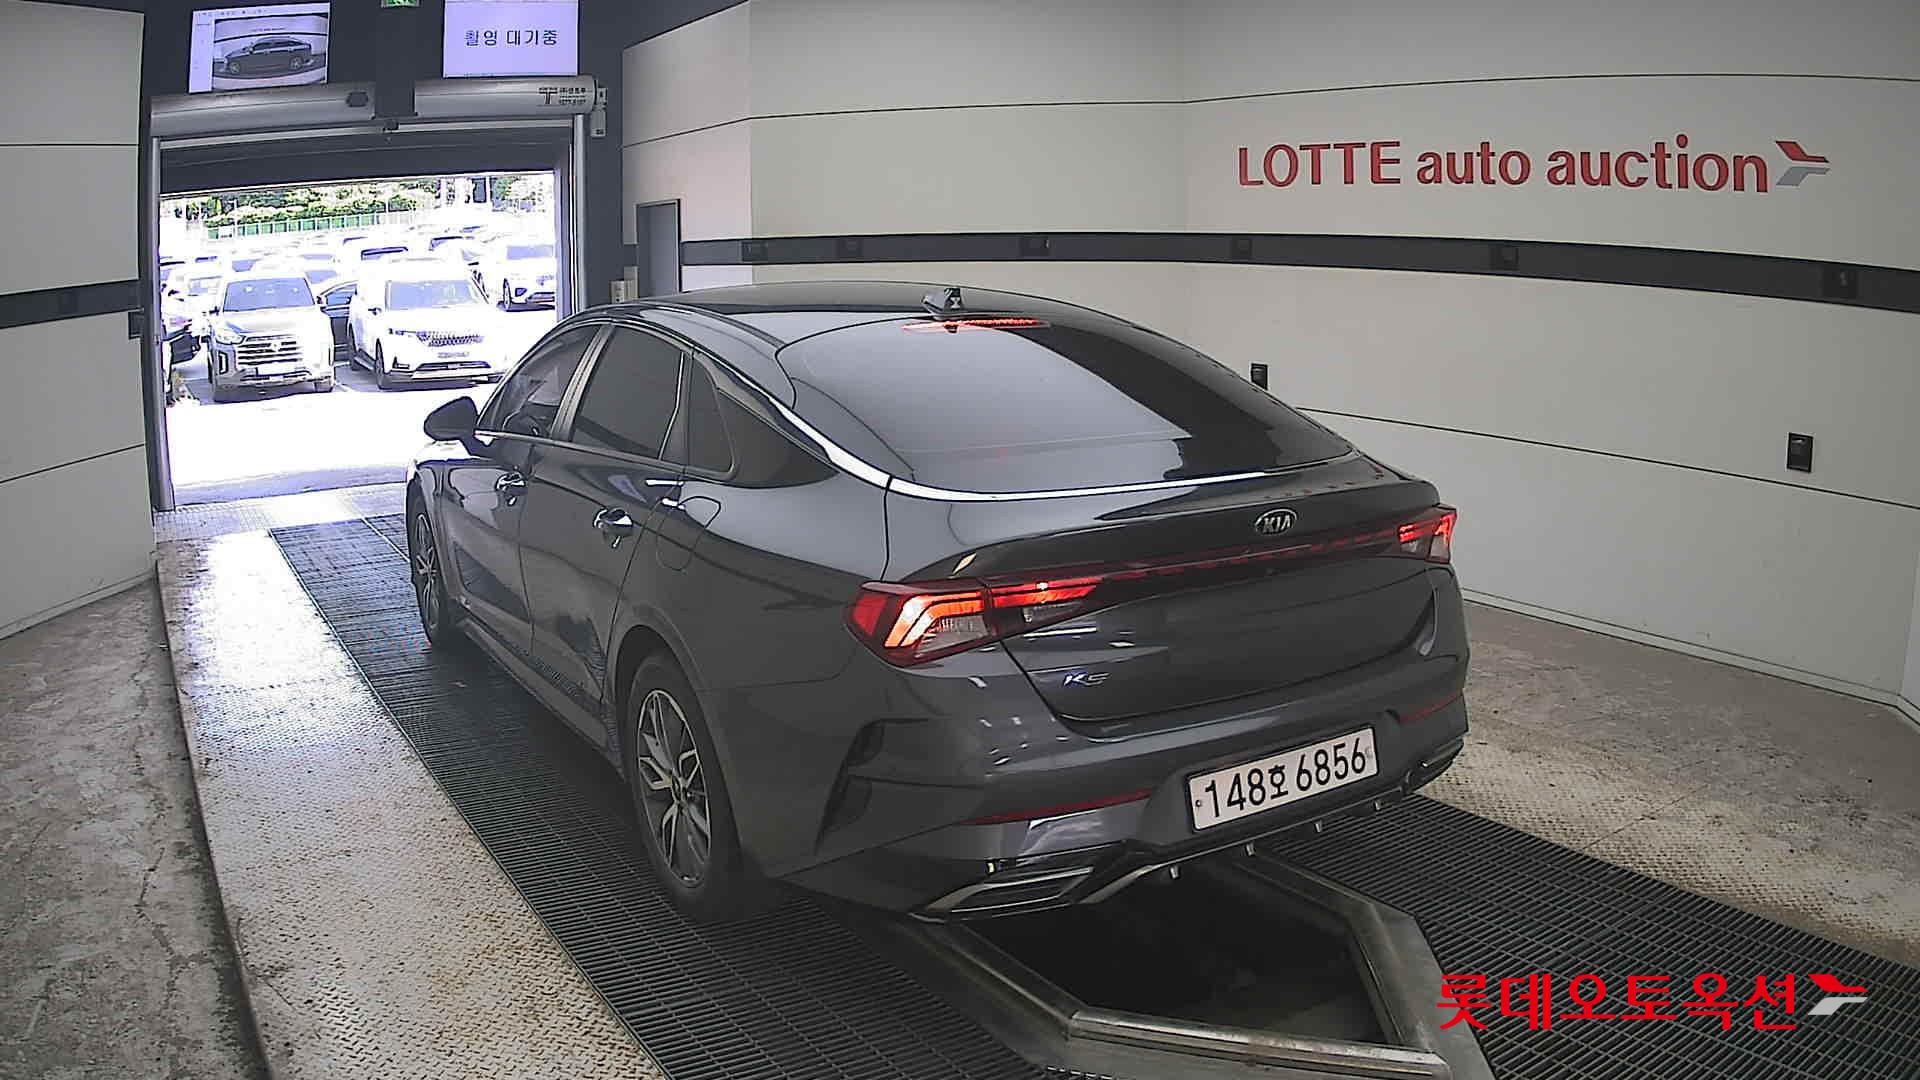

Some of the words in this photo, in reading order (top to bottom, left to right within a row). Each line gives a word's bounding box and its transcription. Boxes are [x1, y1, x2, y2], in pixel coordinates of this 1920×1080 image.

[506, 29, 558, 47] 대기중
[1239, 141, 1400, 187] LOTTE
[1416, 141, 1531, 186] auto
[1547, 133, 1768, 193] auction
[1262, 514, 1292, 533] KIA
[1063, 672, 1110, 687] K5
[1205, 764, 1289, 818] 148호
[1296, 737, 1366, 792] 6856
